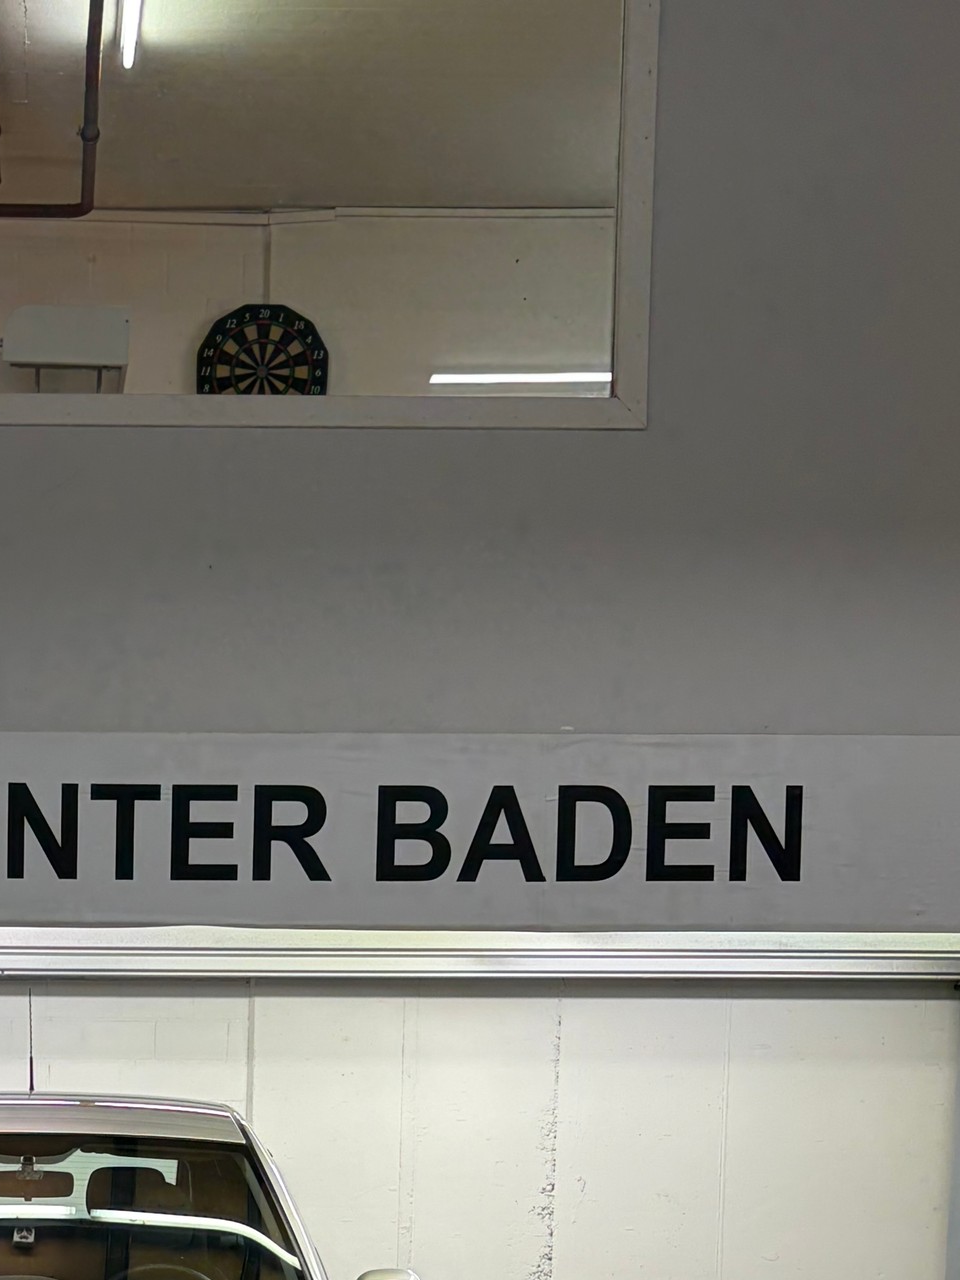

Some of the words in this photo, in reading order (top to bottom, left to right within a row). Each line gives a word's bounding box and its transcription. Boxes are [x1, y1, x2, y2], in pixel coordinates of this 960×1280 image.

[259, 309, 270, 318] 20
[226, 319, 237, 328] 12
[294, 321, 305, 330] 18
[203, 348, 214, 357] 14
[313, 350, 324, 359] 13
[201, 366, 211, 375] 11
[310, 386, 320, 394] 10
[376, 785, 803, 882] BADEN
